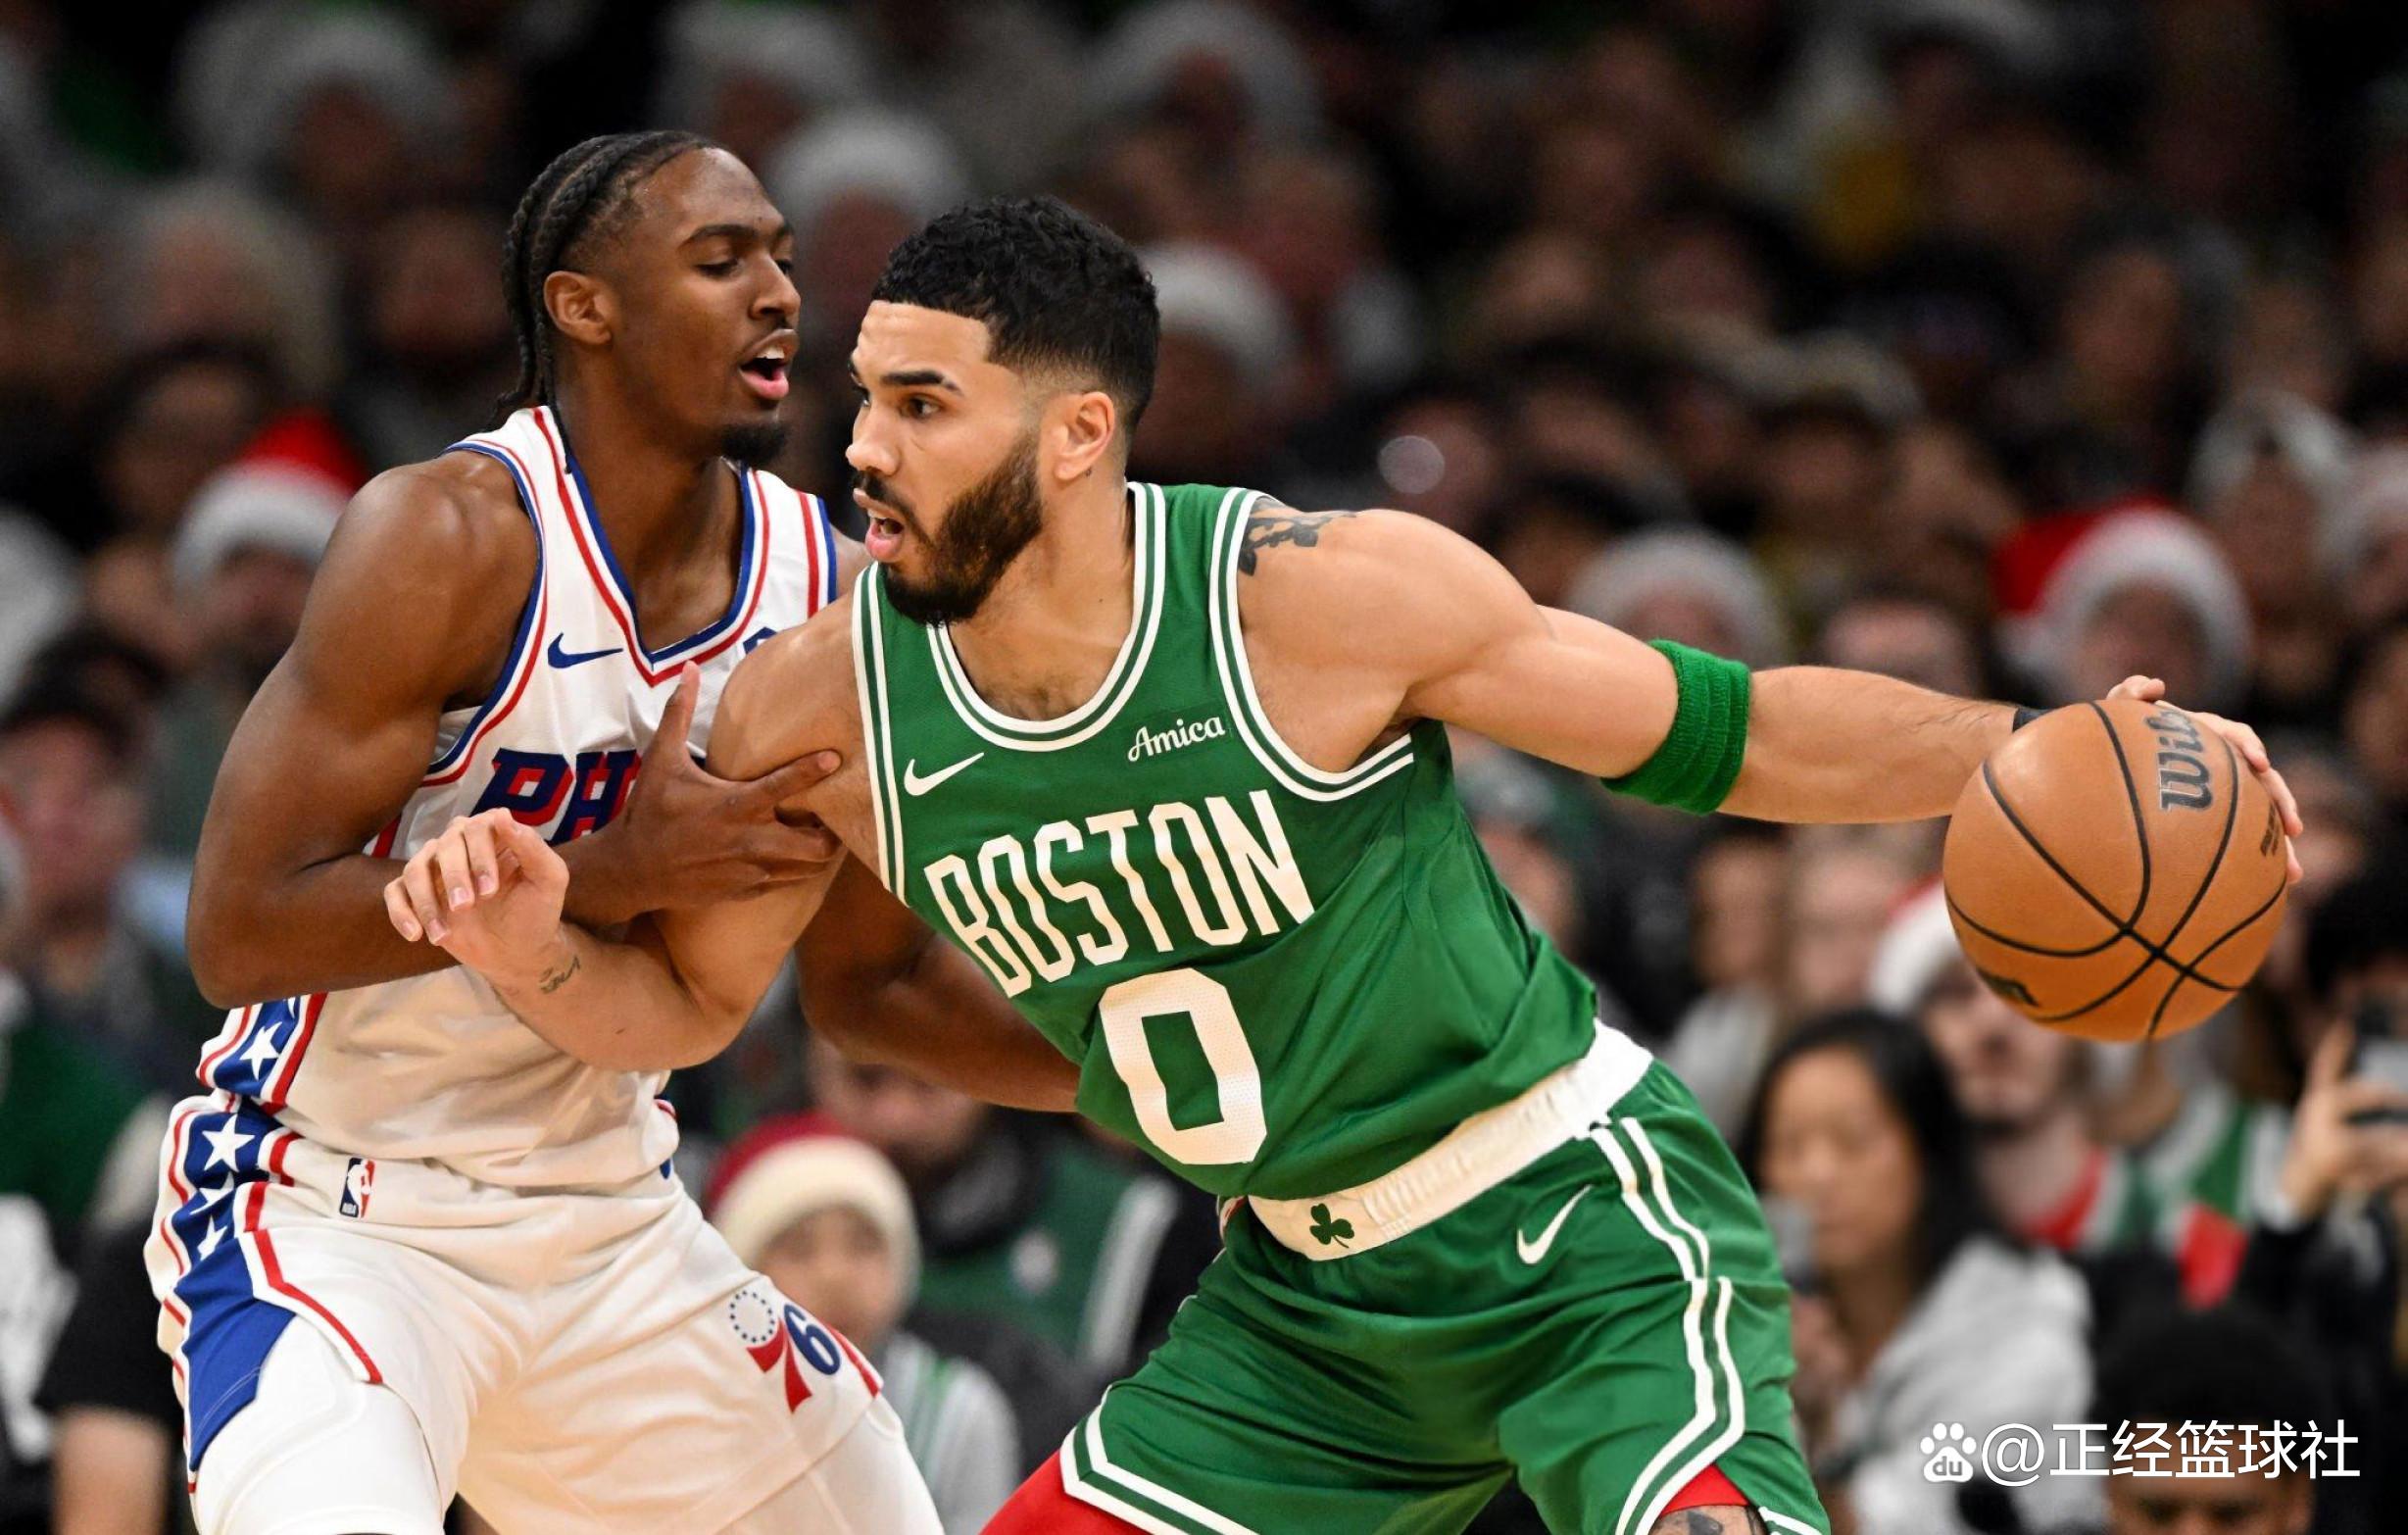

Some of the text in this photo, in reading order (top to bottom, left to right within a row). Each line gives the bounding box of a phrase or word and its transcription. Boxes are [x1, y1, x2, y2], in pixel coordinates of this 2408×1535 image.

[1127, 716, 1227, 763] Amica
[2145, 709, 2213, 813] Wil
[469, 747, 643, 848] PH
[923, 788, 1315, 999] BOSTON
[1098, 966, 1268, 1166] 0
[745, 1303, 842, 1414] 76
